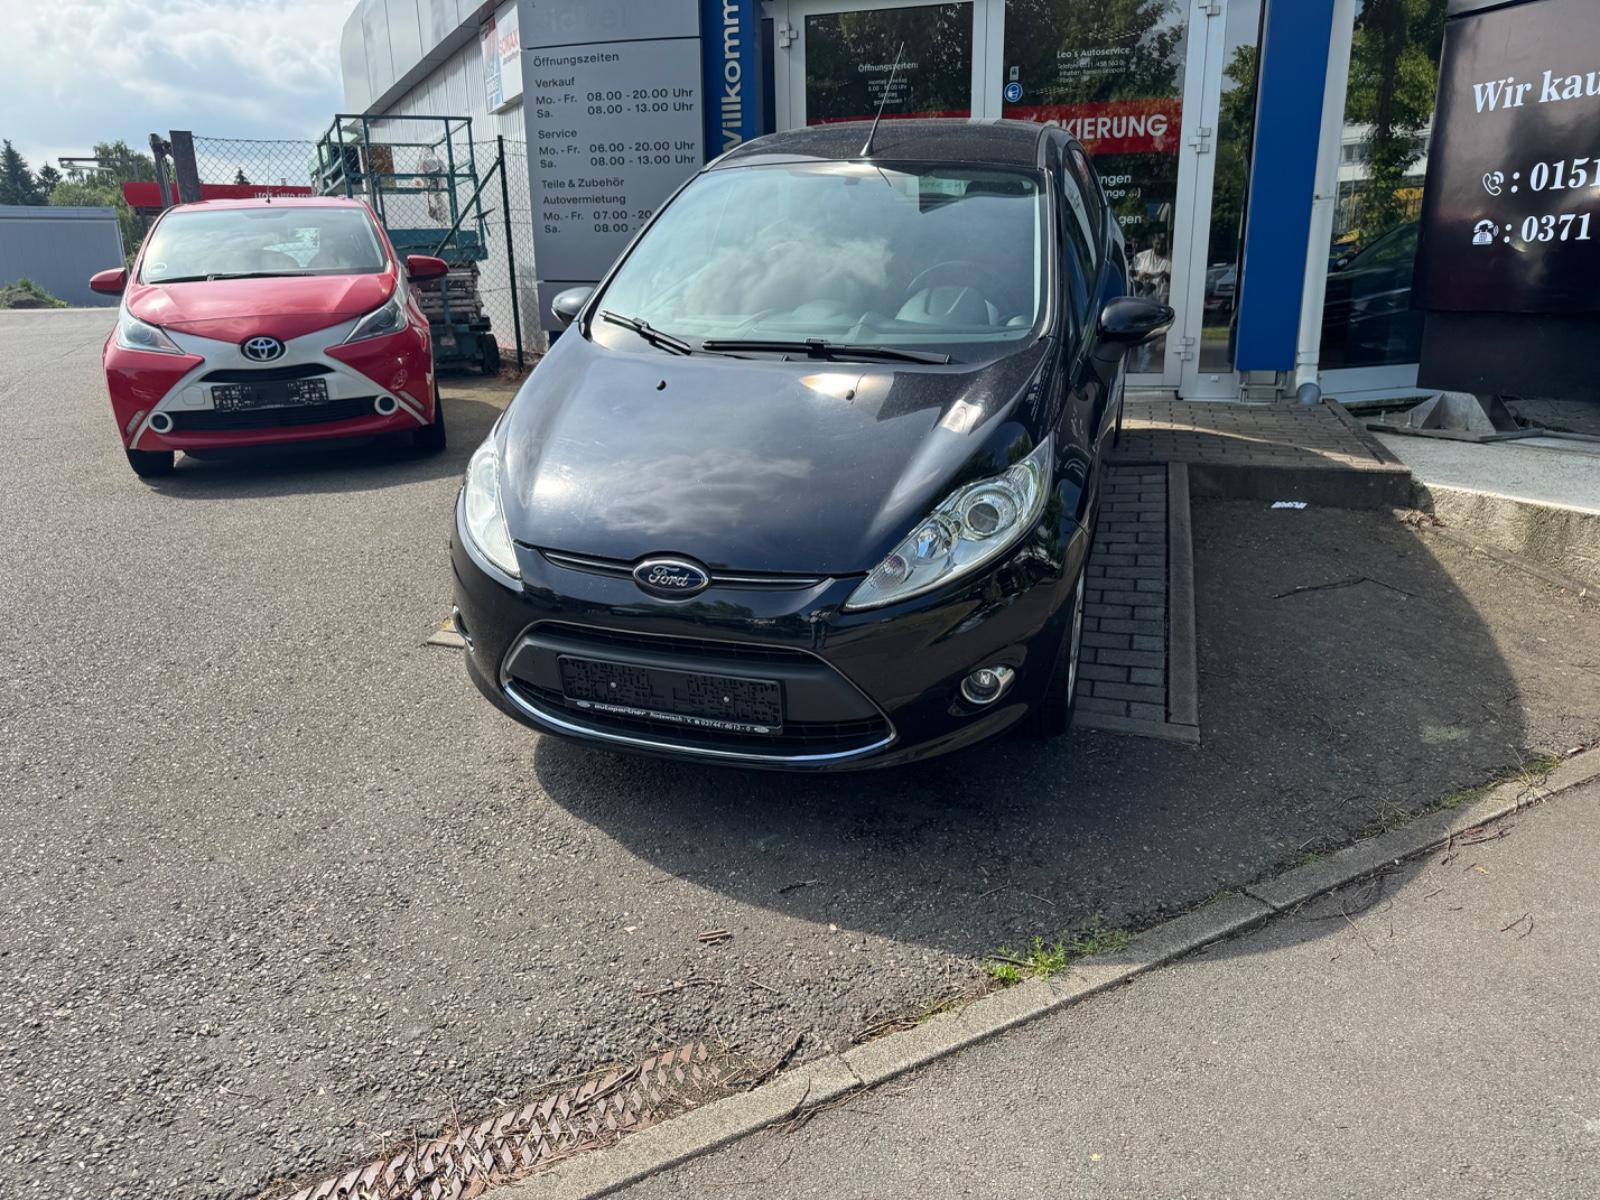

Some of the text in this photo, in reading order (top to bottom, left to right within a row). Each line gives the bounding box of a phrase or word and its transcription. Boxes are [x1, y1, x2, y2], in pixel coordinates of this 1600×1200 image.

[1080, 46, 1131, 57] Autoservice
[533, 51, 620, 68] Öffnungszeiten
[535, 77, 575, 88] Verkauf
[536, 95, 556, 105] Mo.
[564, 93, 578, 104] Fr.
[587, 91, 622, 102] 08.00
[633, 88, 668, 99] 20.00
[672, 87, 693, 98] Uhr
[1473, 76, 1532, 114] Wir
[537, 109, 553, 119] Sa.
[587, 104, 622, 115] 08.00
[635, 102, 669, 113] 13.00
[673, 101, 694, 112] Uhr
[538, 129, 578, 140] Service
[539, 146, 559, 156] Mo.
[567, 145, 580, 155] Fr.
[589, 143, 625, 153] 06.00
[634, 141, 670, 152] 20.00
[674, 141, 695, 151] Uhr
[540, 159, 557, 169] Sa.
[590, 156, 625, 167] 08.00
[638, 155, 671, 165] 13.00
[675, 154, 696, 164] Uhr
[542, 177, 624, 189] Teile & Zubehör
[543, 194, 626, 206] Autovermietung
[543, 212, 564, 221] Mo.
[571, 211, 584, 220] Fr.
[593, 210, 628, 220] 07.00
[545, 225, 561, 234] Sa.
[594, 223, 628, 233] 08.00
[1521, 213, 1591, 242] 0371
[649, 565, 689, 587] Ford
